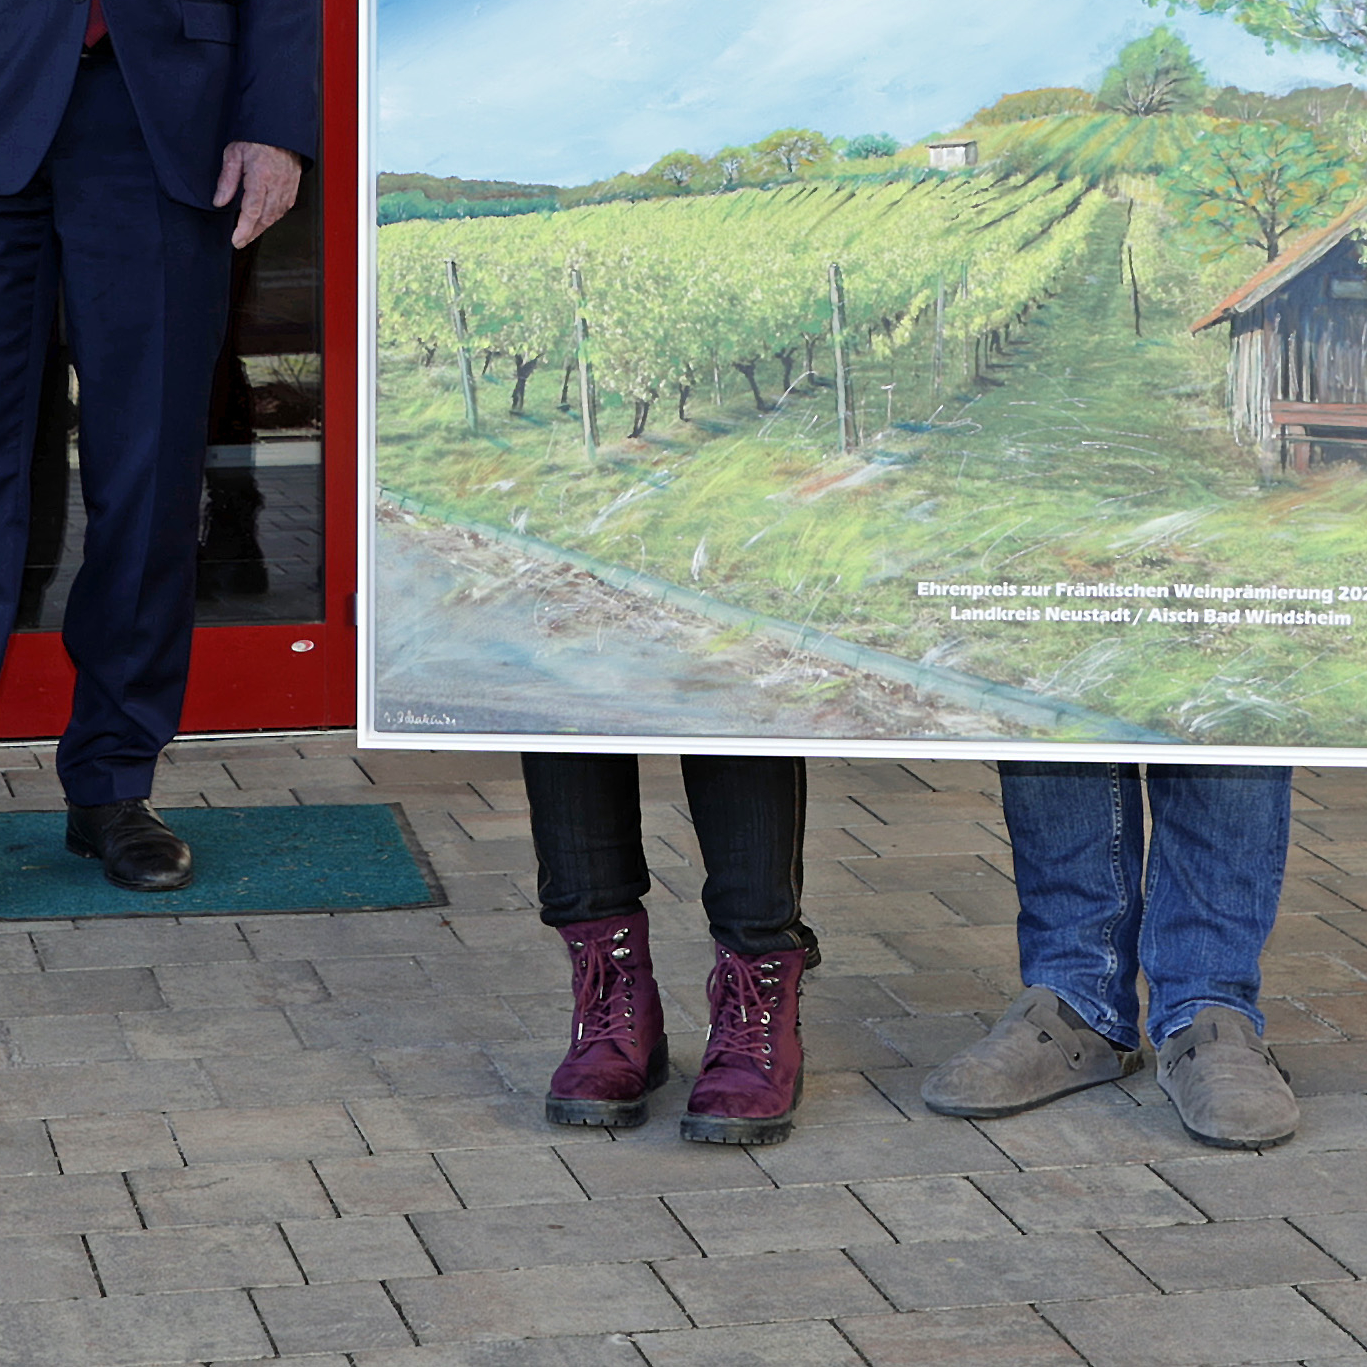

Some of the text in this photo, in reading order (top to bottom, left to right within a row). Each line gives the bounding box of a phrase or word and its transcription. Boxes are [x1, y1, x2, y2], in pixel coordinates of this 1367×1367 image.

[917, 581, 1017, 600] Ehrenpreis
[1021, 584, 1051, 597] zur
[1055, 582, 1169, 598] Fränkischen
[1174, 583, 1334, 604] Weinprämierung
[950, 606, 1040, 621] Landkreis
[1045, 606, 1131, 622] Neustadt
[1147, 607, 1199, 623] Aisch
[1204, 608, 1240, 624] Bad
[1244, 609, 1352, 626] Windsheim
